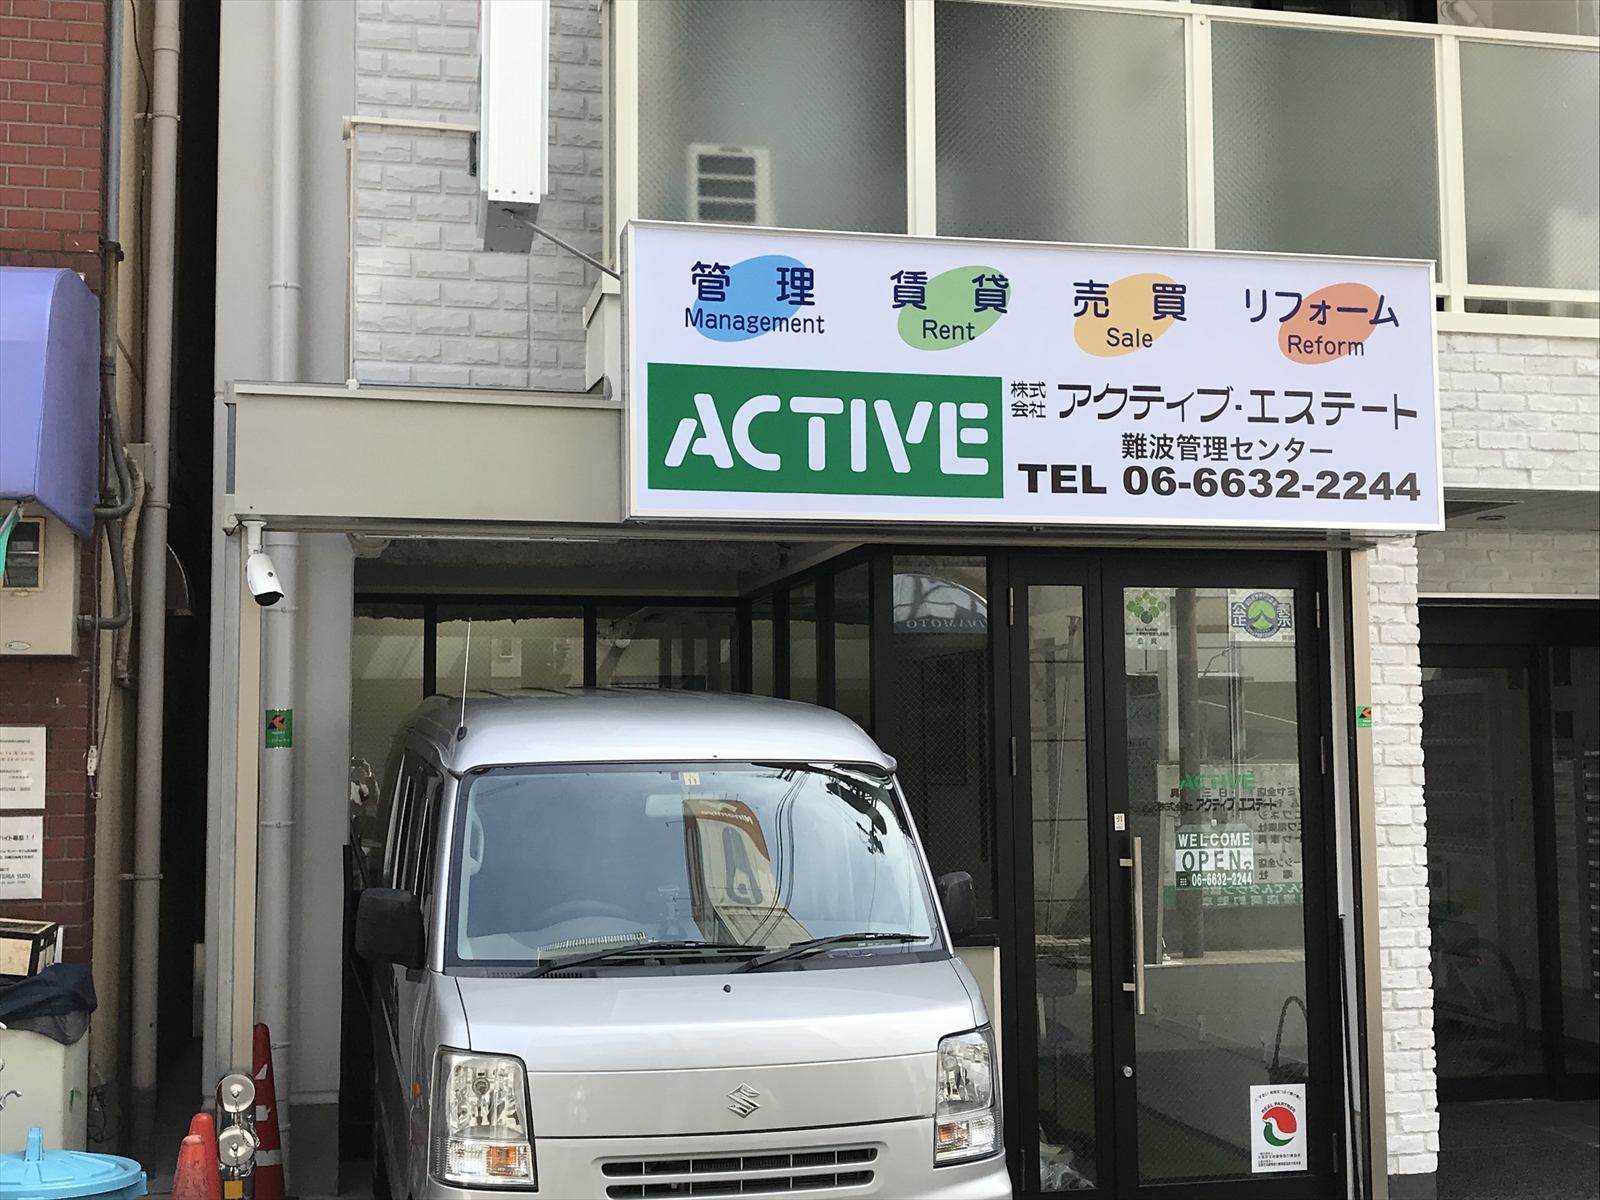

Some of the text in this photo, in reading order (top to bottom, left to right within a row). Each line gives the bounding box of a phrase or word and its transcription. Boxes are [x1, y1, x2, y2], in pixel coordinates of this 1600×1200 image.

[1245, 288, 1400, 327] リフォーム
[685, 307, 825, 336] Management
[922, 319, 976, 341] Rent
[1106, 327, 1153, 348] Sale
[1287, 335, 1365, 357] Reform
[664, 392, 989, 476] ACTIVE
[1121, 433, 1333, 463] 難波管理センター
[1018, 463, 1421, 501] TEL 06-6632-2244
[1232, 602, 1247, 626] 公正
[1178, 773, 1256, 790] ACTIVE
[1178, 832, 1250, 848] WELCOME
[1182, 850, 1241, 871] OPEN
[1191, 872, 1253, 887] 06-6632-2244
[1274, 1101, 1296, 1113] PARTNER
